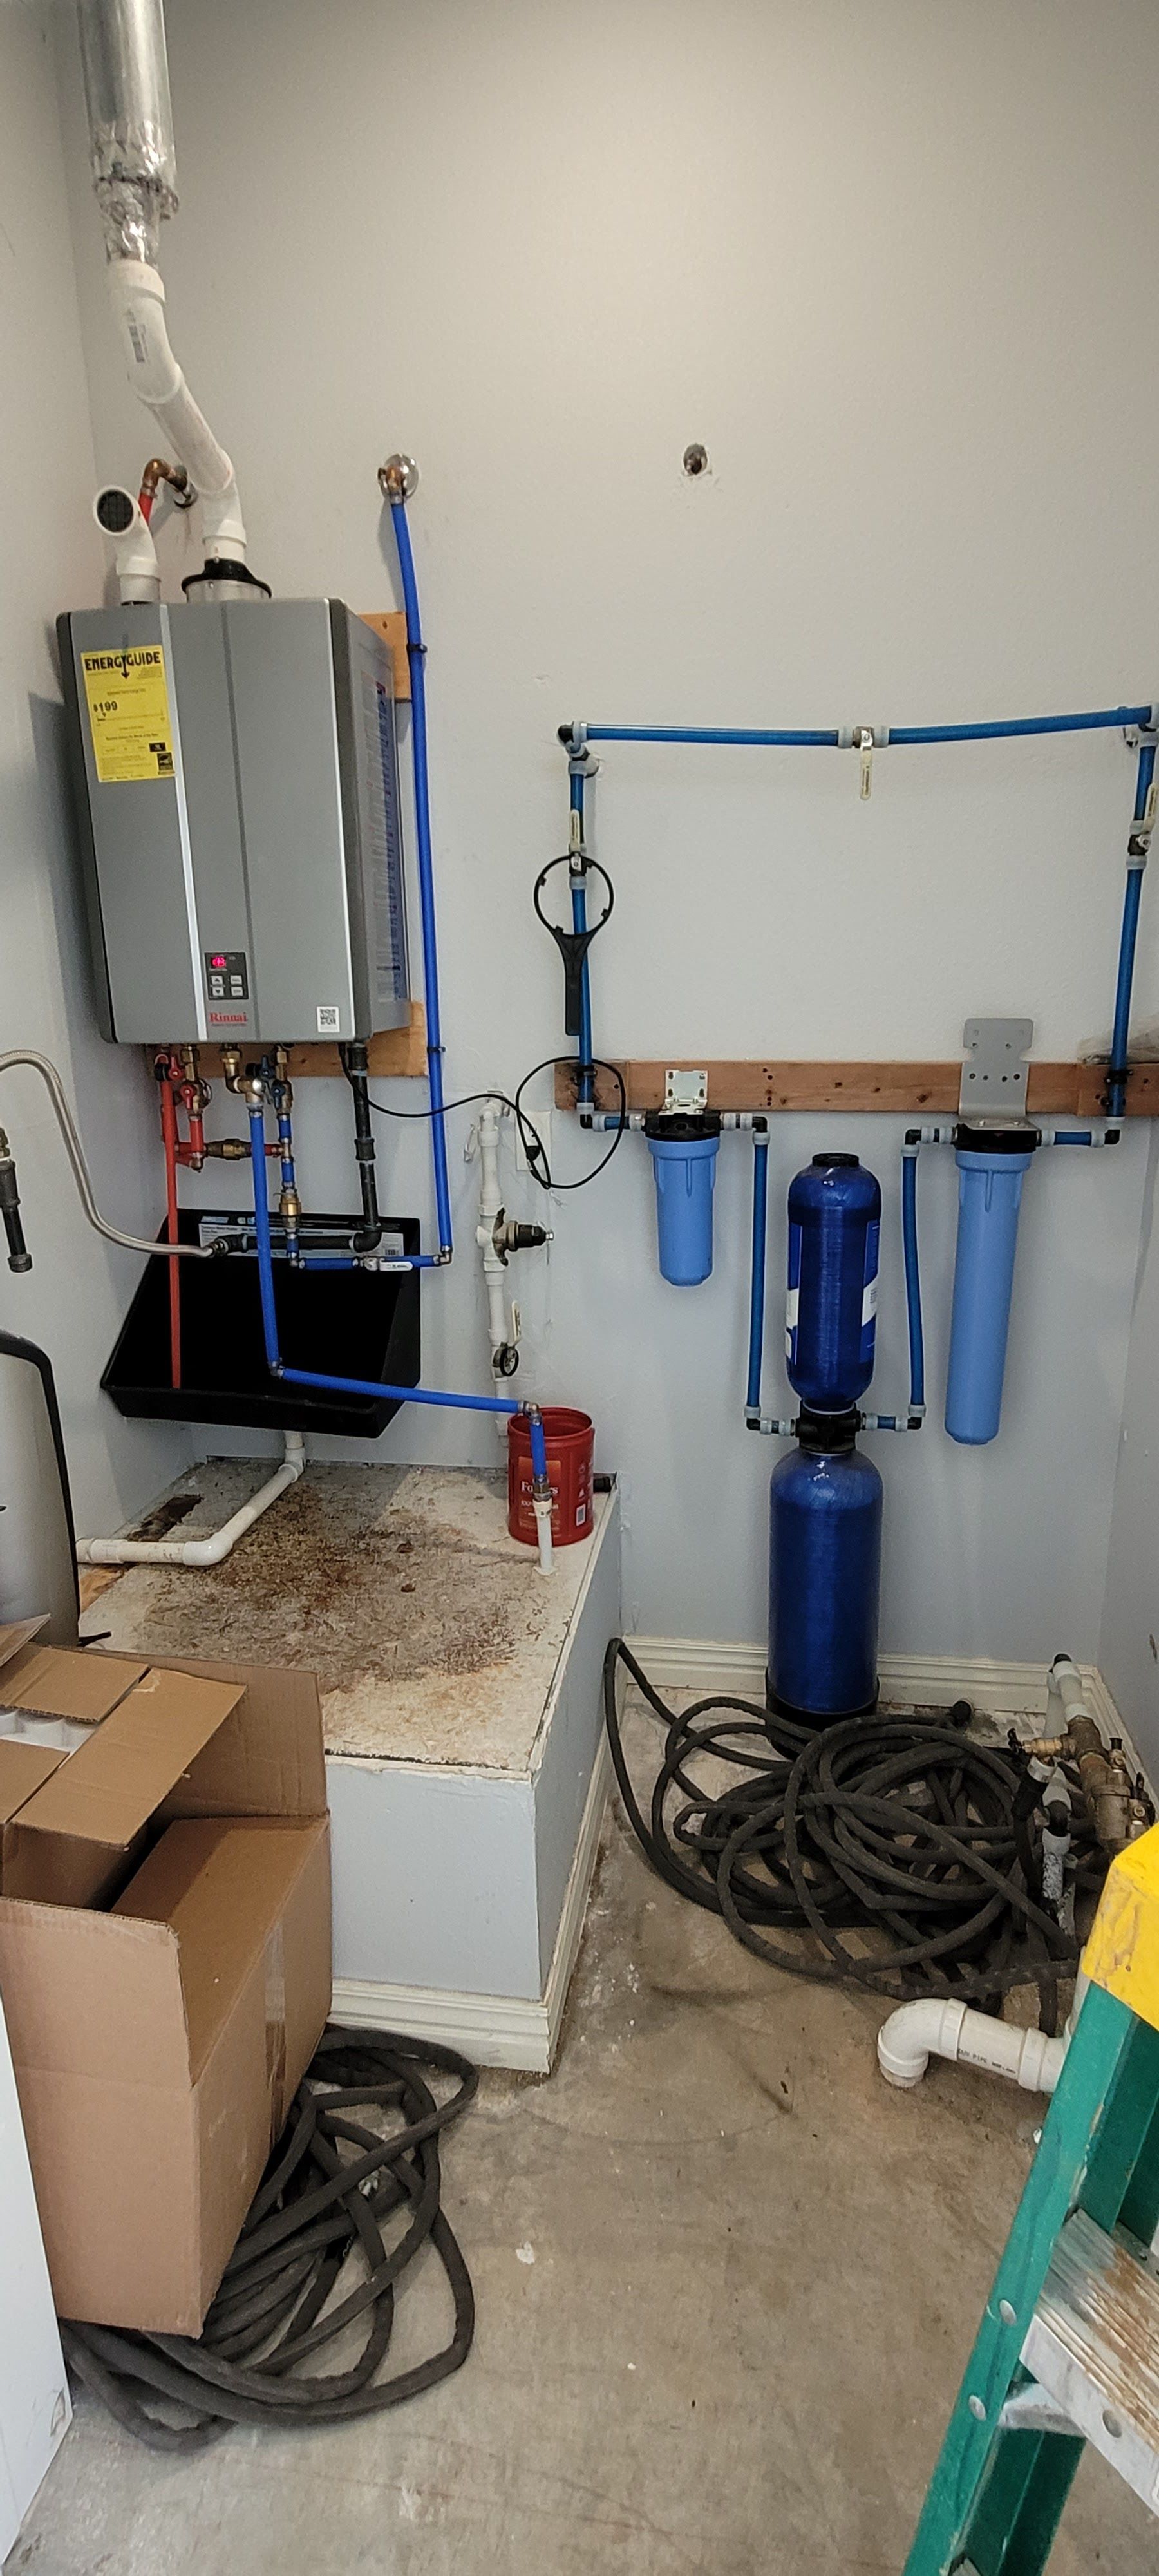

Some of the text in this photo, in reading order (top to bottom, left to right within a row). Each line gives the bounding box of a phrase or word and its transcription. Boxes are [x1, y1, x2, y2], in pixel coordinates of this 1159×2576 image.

[84, 651, 161, 674] ENERGYGUIDE
[93, 701, 117, 712] $199
[210, 1012, 247, 1023] Rinnai
